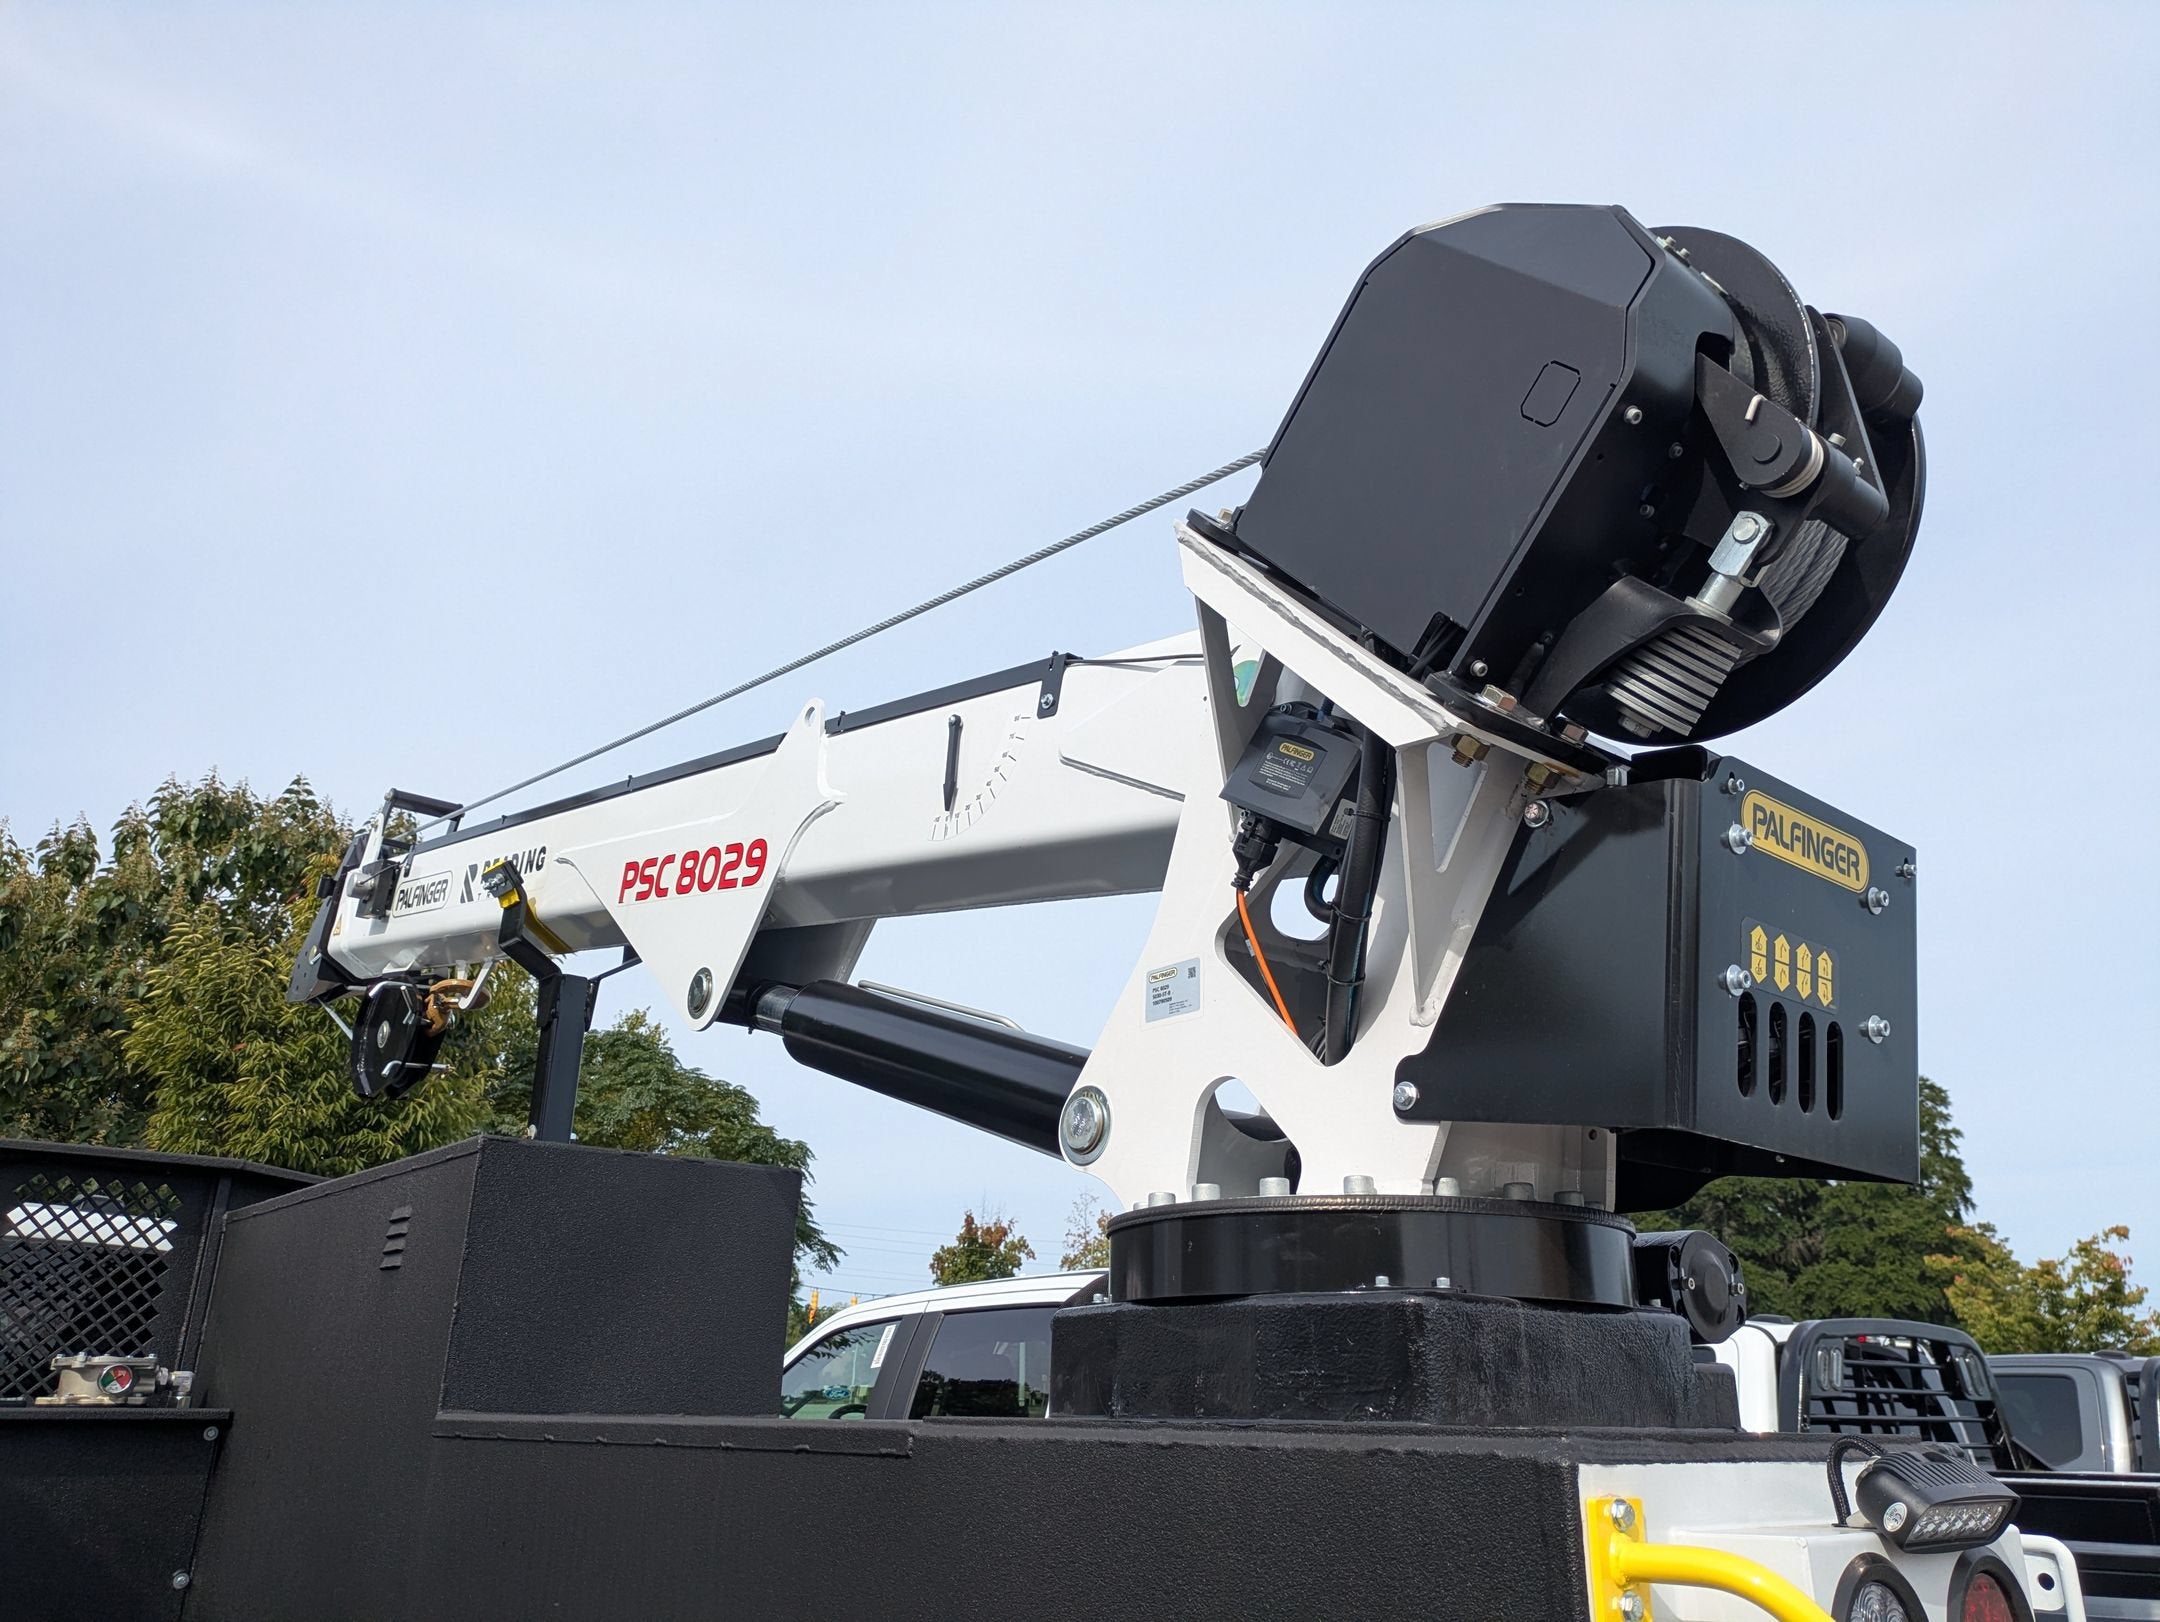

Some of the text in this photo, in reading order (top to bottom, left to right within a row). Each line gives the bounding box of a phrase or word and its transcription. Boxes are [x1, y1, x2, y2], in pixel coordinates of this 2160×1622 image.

[618, 838, 768, 904] PSC 8029
[1753, 802, 1860, 882] PALFINGER
[395, 879, 449, 911] PALFINGER
